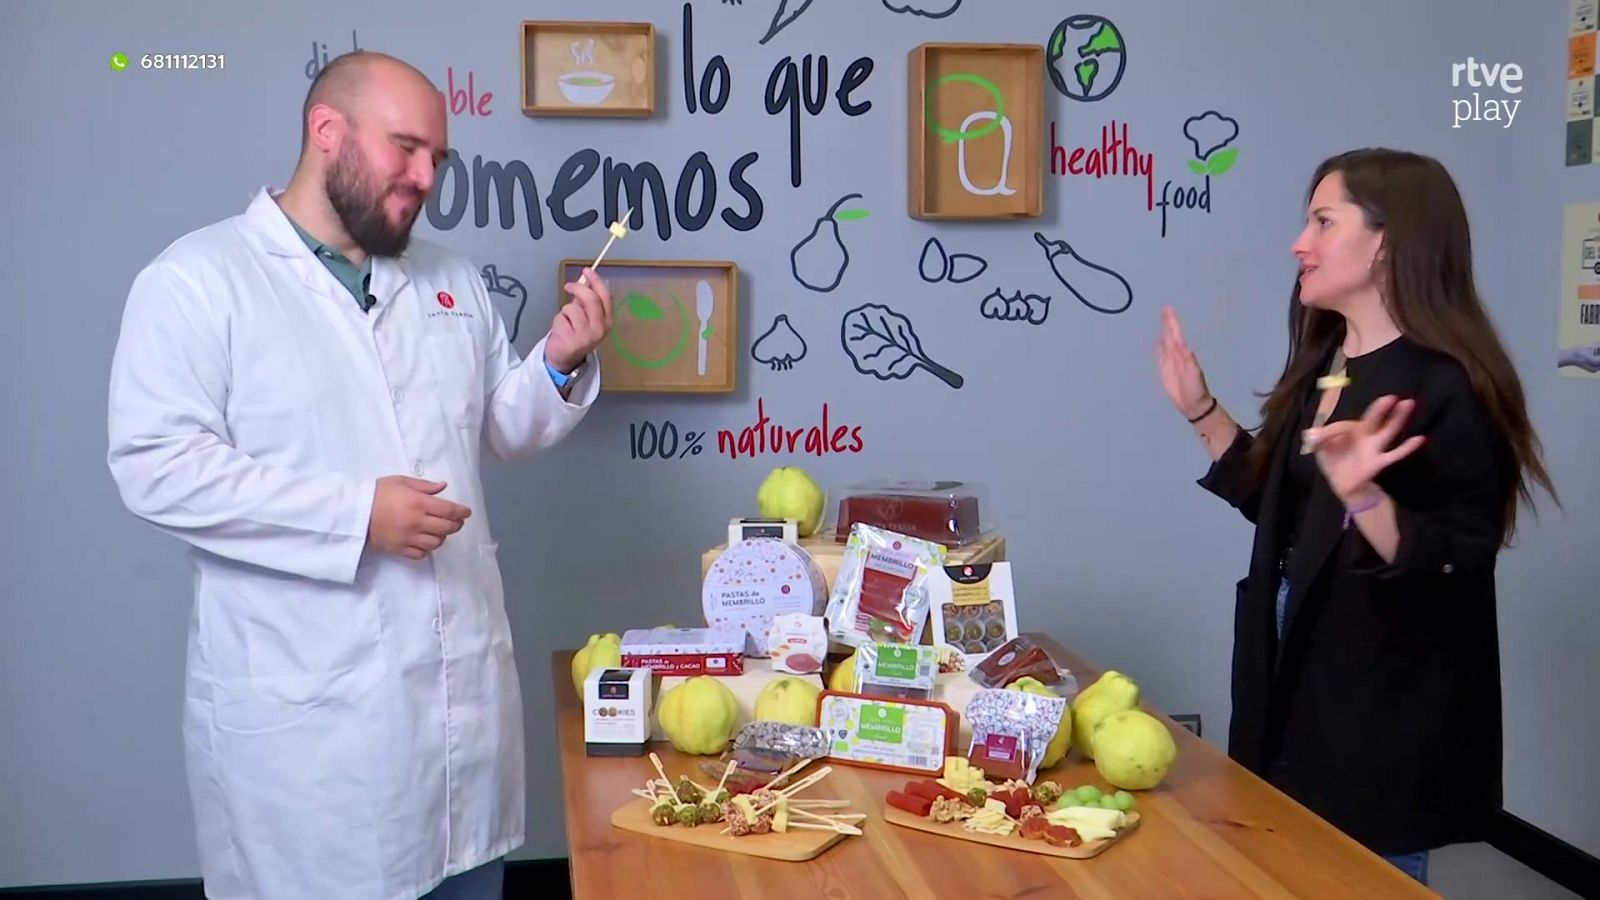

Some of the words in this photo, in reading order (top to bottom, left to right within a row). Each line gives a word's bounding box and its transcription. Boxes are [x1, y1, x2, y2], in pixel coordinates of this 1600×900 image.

[683, 2, 731, 115] lo
[765, 54, 874, 188] que
[425, 146, 764, 241] omemos
[1050, 120, 1153, 211] healthy
[1156, 174, 1211, 238] food
[629, 420, 706, 460] 100%
[717, 396, 863, 460] naturales
[870, 553, 914, 570] MEMBRILLO
[721, 591, 749, 599] PASTAS
[722, 598, 766, 607] MEMBRILLO
[860, 721, 902, 735] MEMBRILLO
